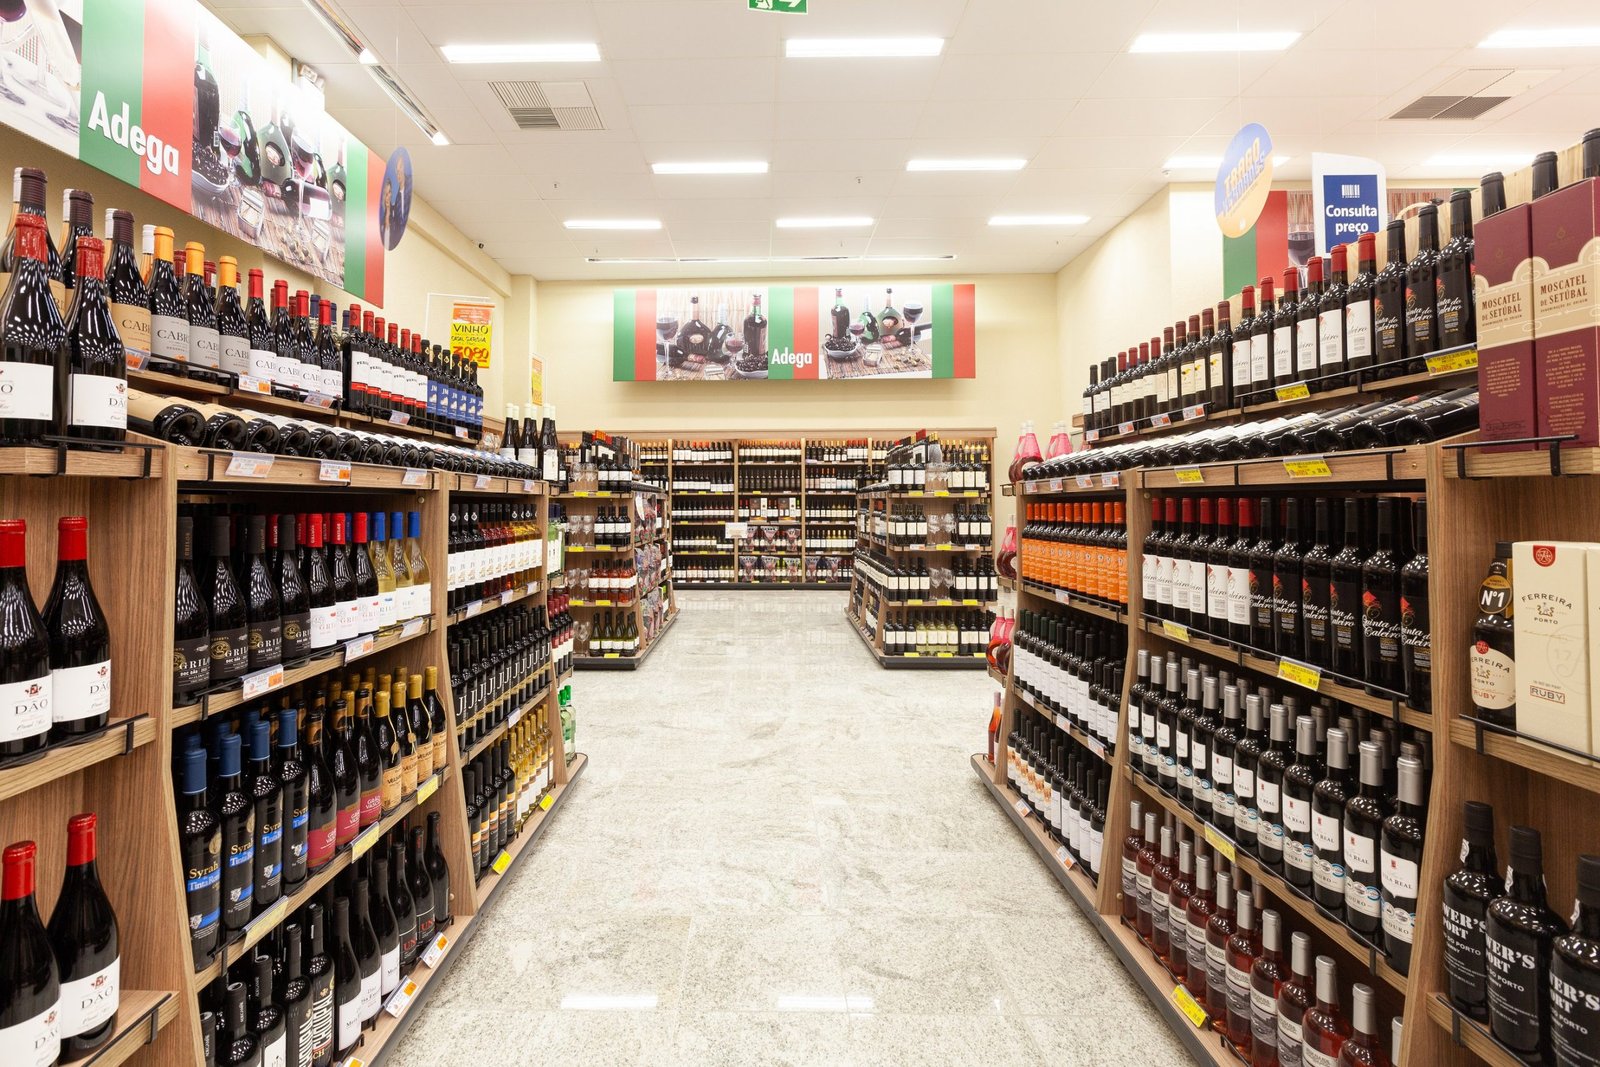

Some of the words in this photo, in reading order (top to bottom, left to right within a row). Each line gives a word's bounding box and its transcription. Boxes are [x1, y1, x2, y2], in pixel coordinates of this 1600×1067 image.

[88, 91, 179, 177] Adega
[1325, 204, 1378, 218] Consulta
[1335, 222, 1369, 236] preço
[1540, 274, 1588, 296] MOSCATEL
[1481, 292, 1522, 311] MOSCATEL
[1540, 300, 1548, 308] DE
[1549, 287, 1589, 305] SETÚBAL
[1489, 303, 1523, 320] SETÚBAL
[453, 324, 489, 334] VINHO
[771, 348, 813, 367] Adega
[1521, 592, 1573, 610] FERREIRA
[1362, 614, 1390, 628] Quinta
[1533, 616, 1559, 625] PORTO
[1364, 626, 1401, 638] Caleiro
[1530, 687, 1563, 701] RUBY
[15, 698, 48, 715] DÃO
[1292, 816, 1307, 826] REAL
[1320, 834, 1335, 844] REAL
[1353, 855, 1369, 865] REAL
[189, 861, 219, 880] Syrah
[189, 878, 208, 892] Tinta
[1394, 879, 1413, 890] REAL
[1455, 940, 1481, 956] PORTO
[1497, 974, 1525, 993] PORTO
[1558, 1013, 1588, 1035] PORTO
